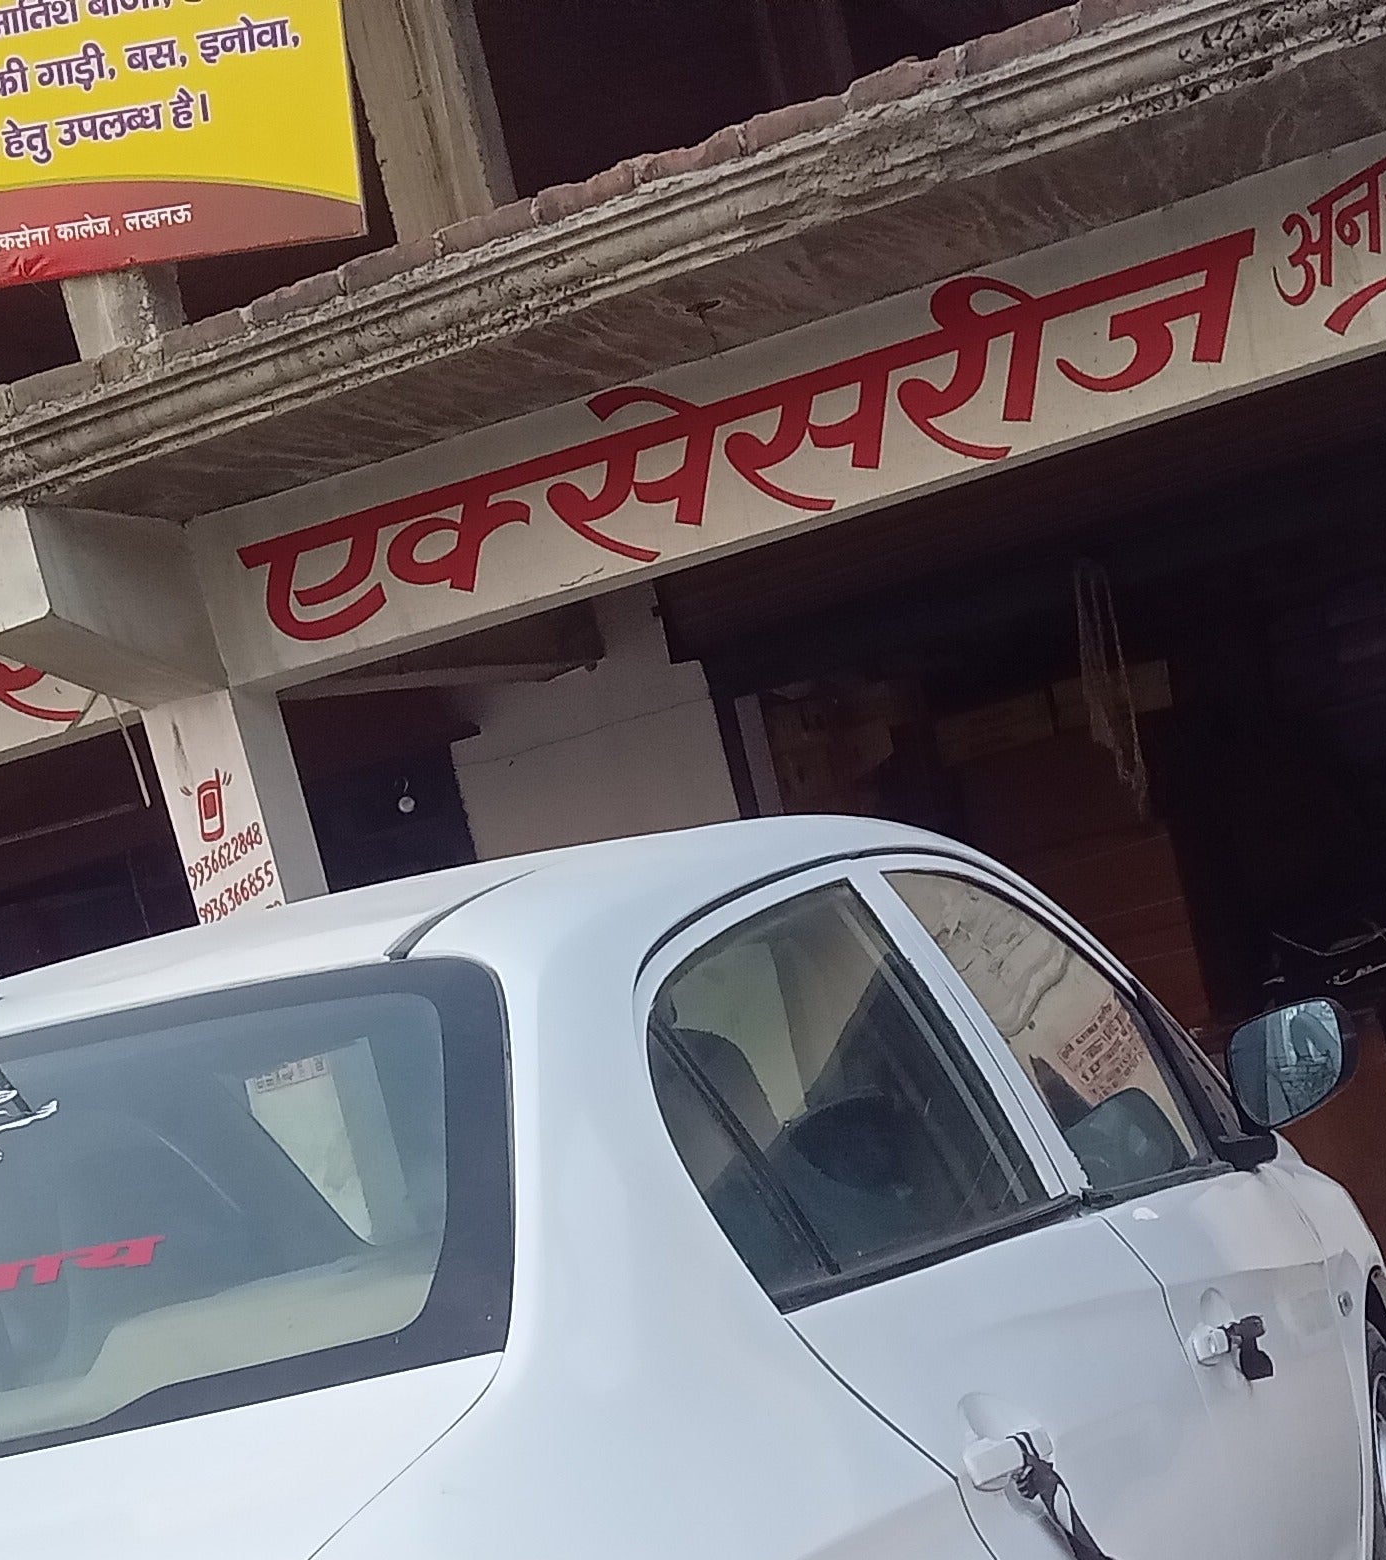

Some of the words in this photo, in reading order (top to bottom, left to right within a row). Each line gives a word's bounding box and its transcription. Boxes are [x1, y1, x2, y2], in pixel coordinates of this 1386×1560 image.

[35, 42, 116, 91] गाड़ी,
[125, 40, 187, 71] बस,
[196, 16, 301, 63] इनोवा,
[2, 119, 53, 164] हेतु
[55, 104, 162, 146] उपलब्ध
[122, 202, 193, 232] लखनऊ
